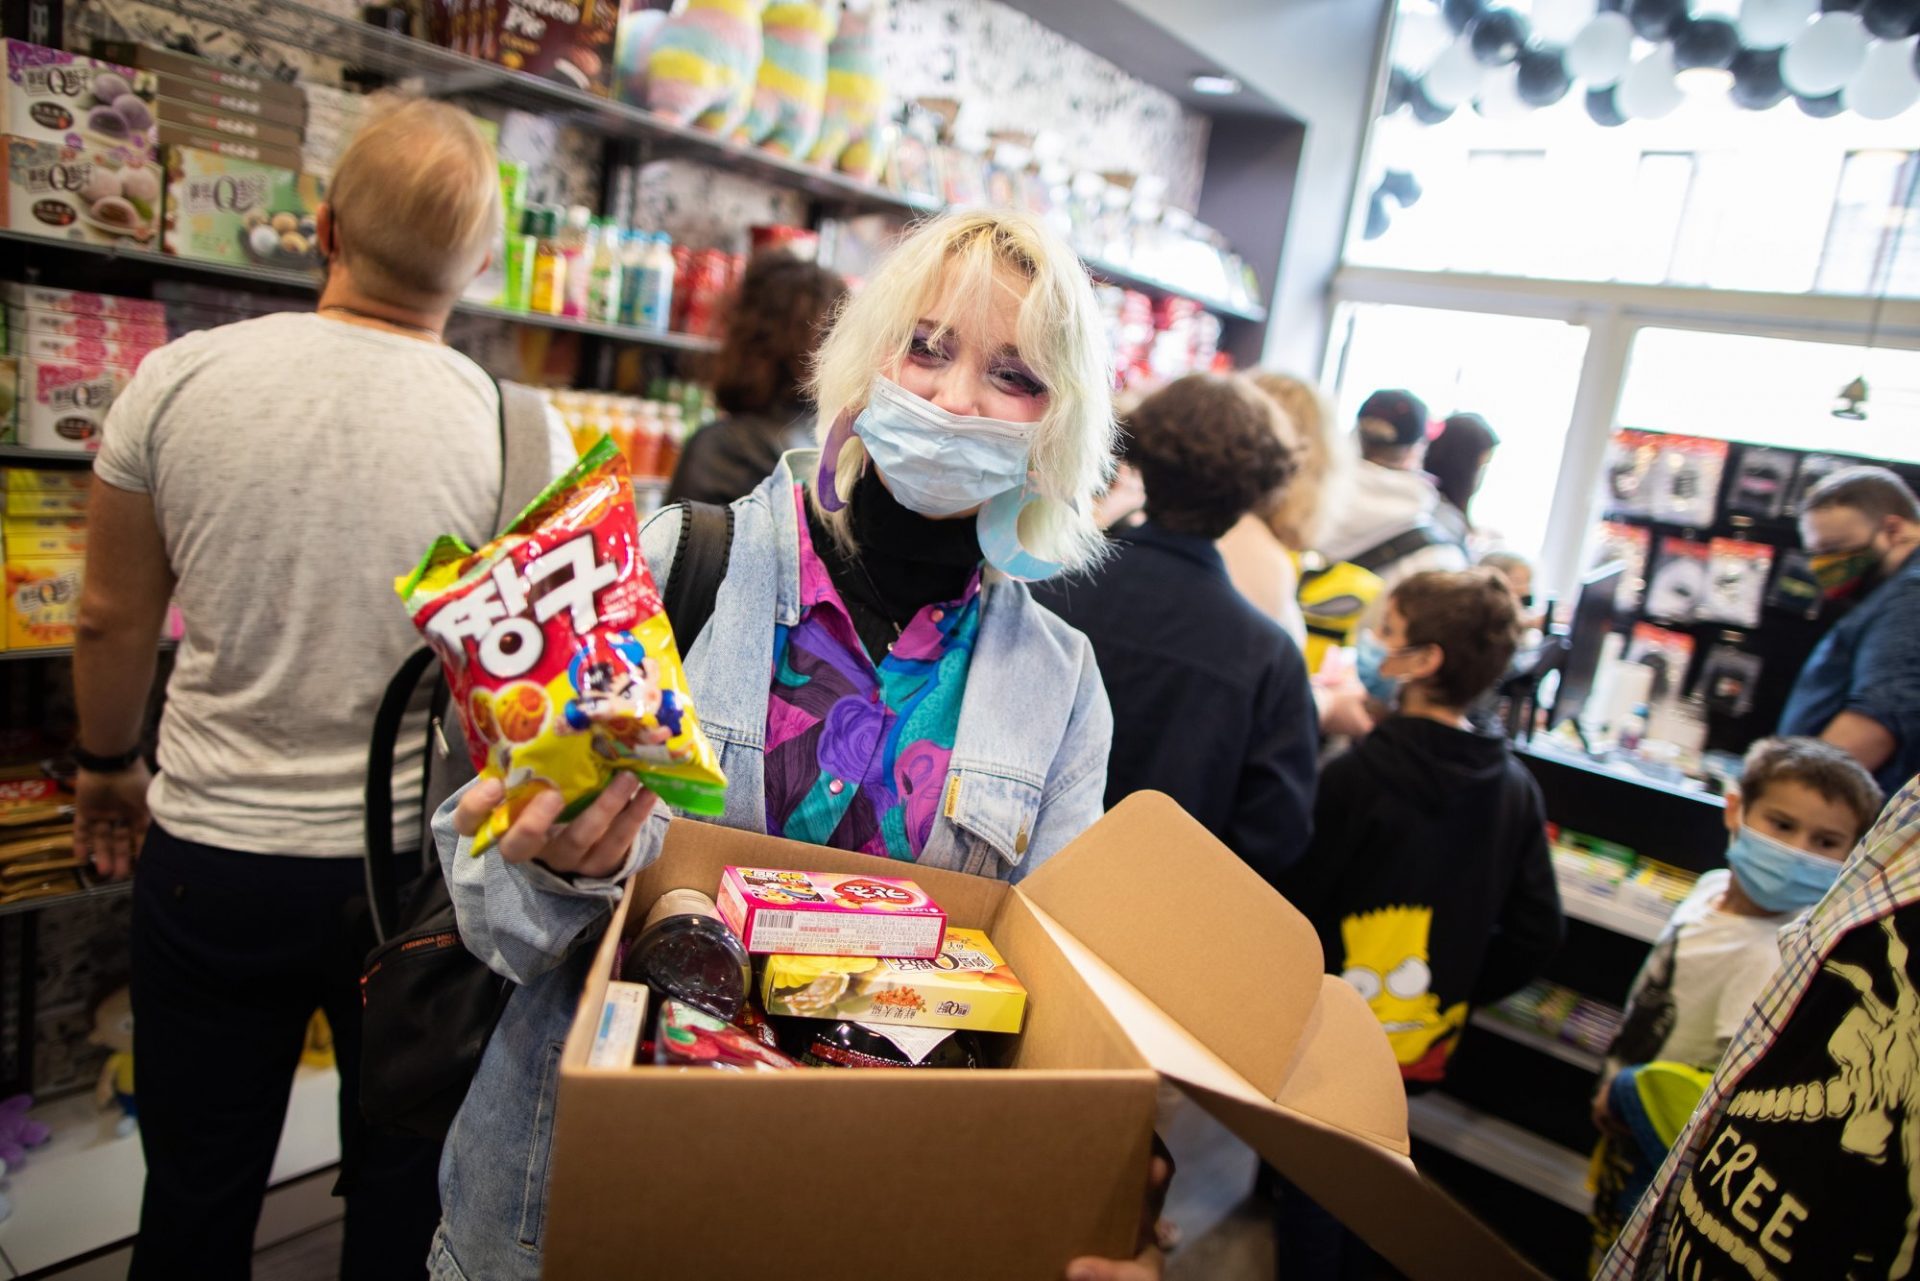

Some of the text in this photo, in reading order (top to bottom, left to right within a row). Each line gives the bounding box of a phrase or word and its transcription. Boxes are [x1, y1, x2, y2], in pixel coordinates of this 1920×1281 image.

[503, 4, 547, 39] Pie
[425, 532, 619, 678] 짱구
[1700, 1124, 1808, 1264] FREE
